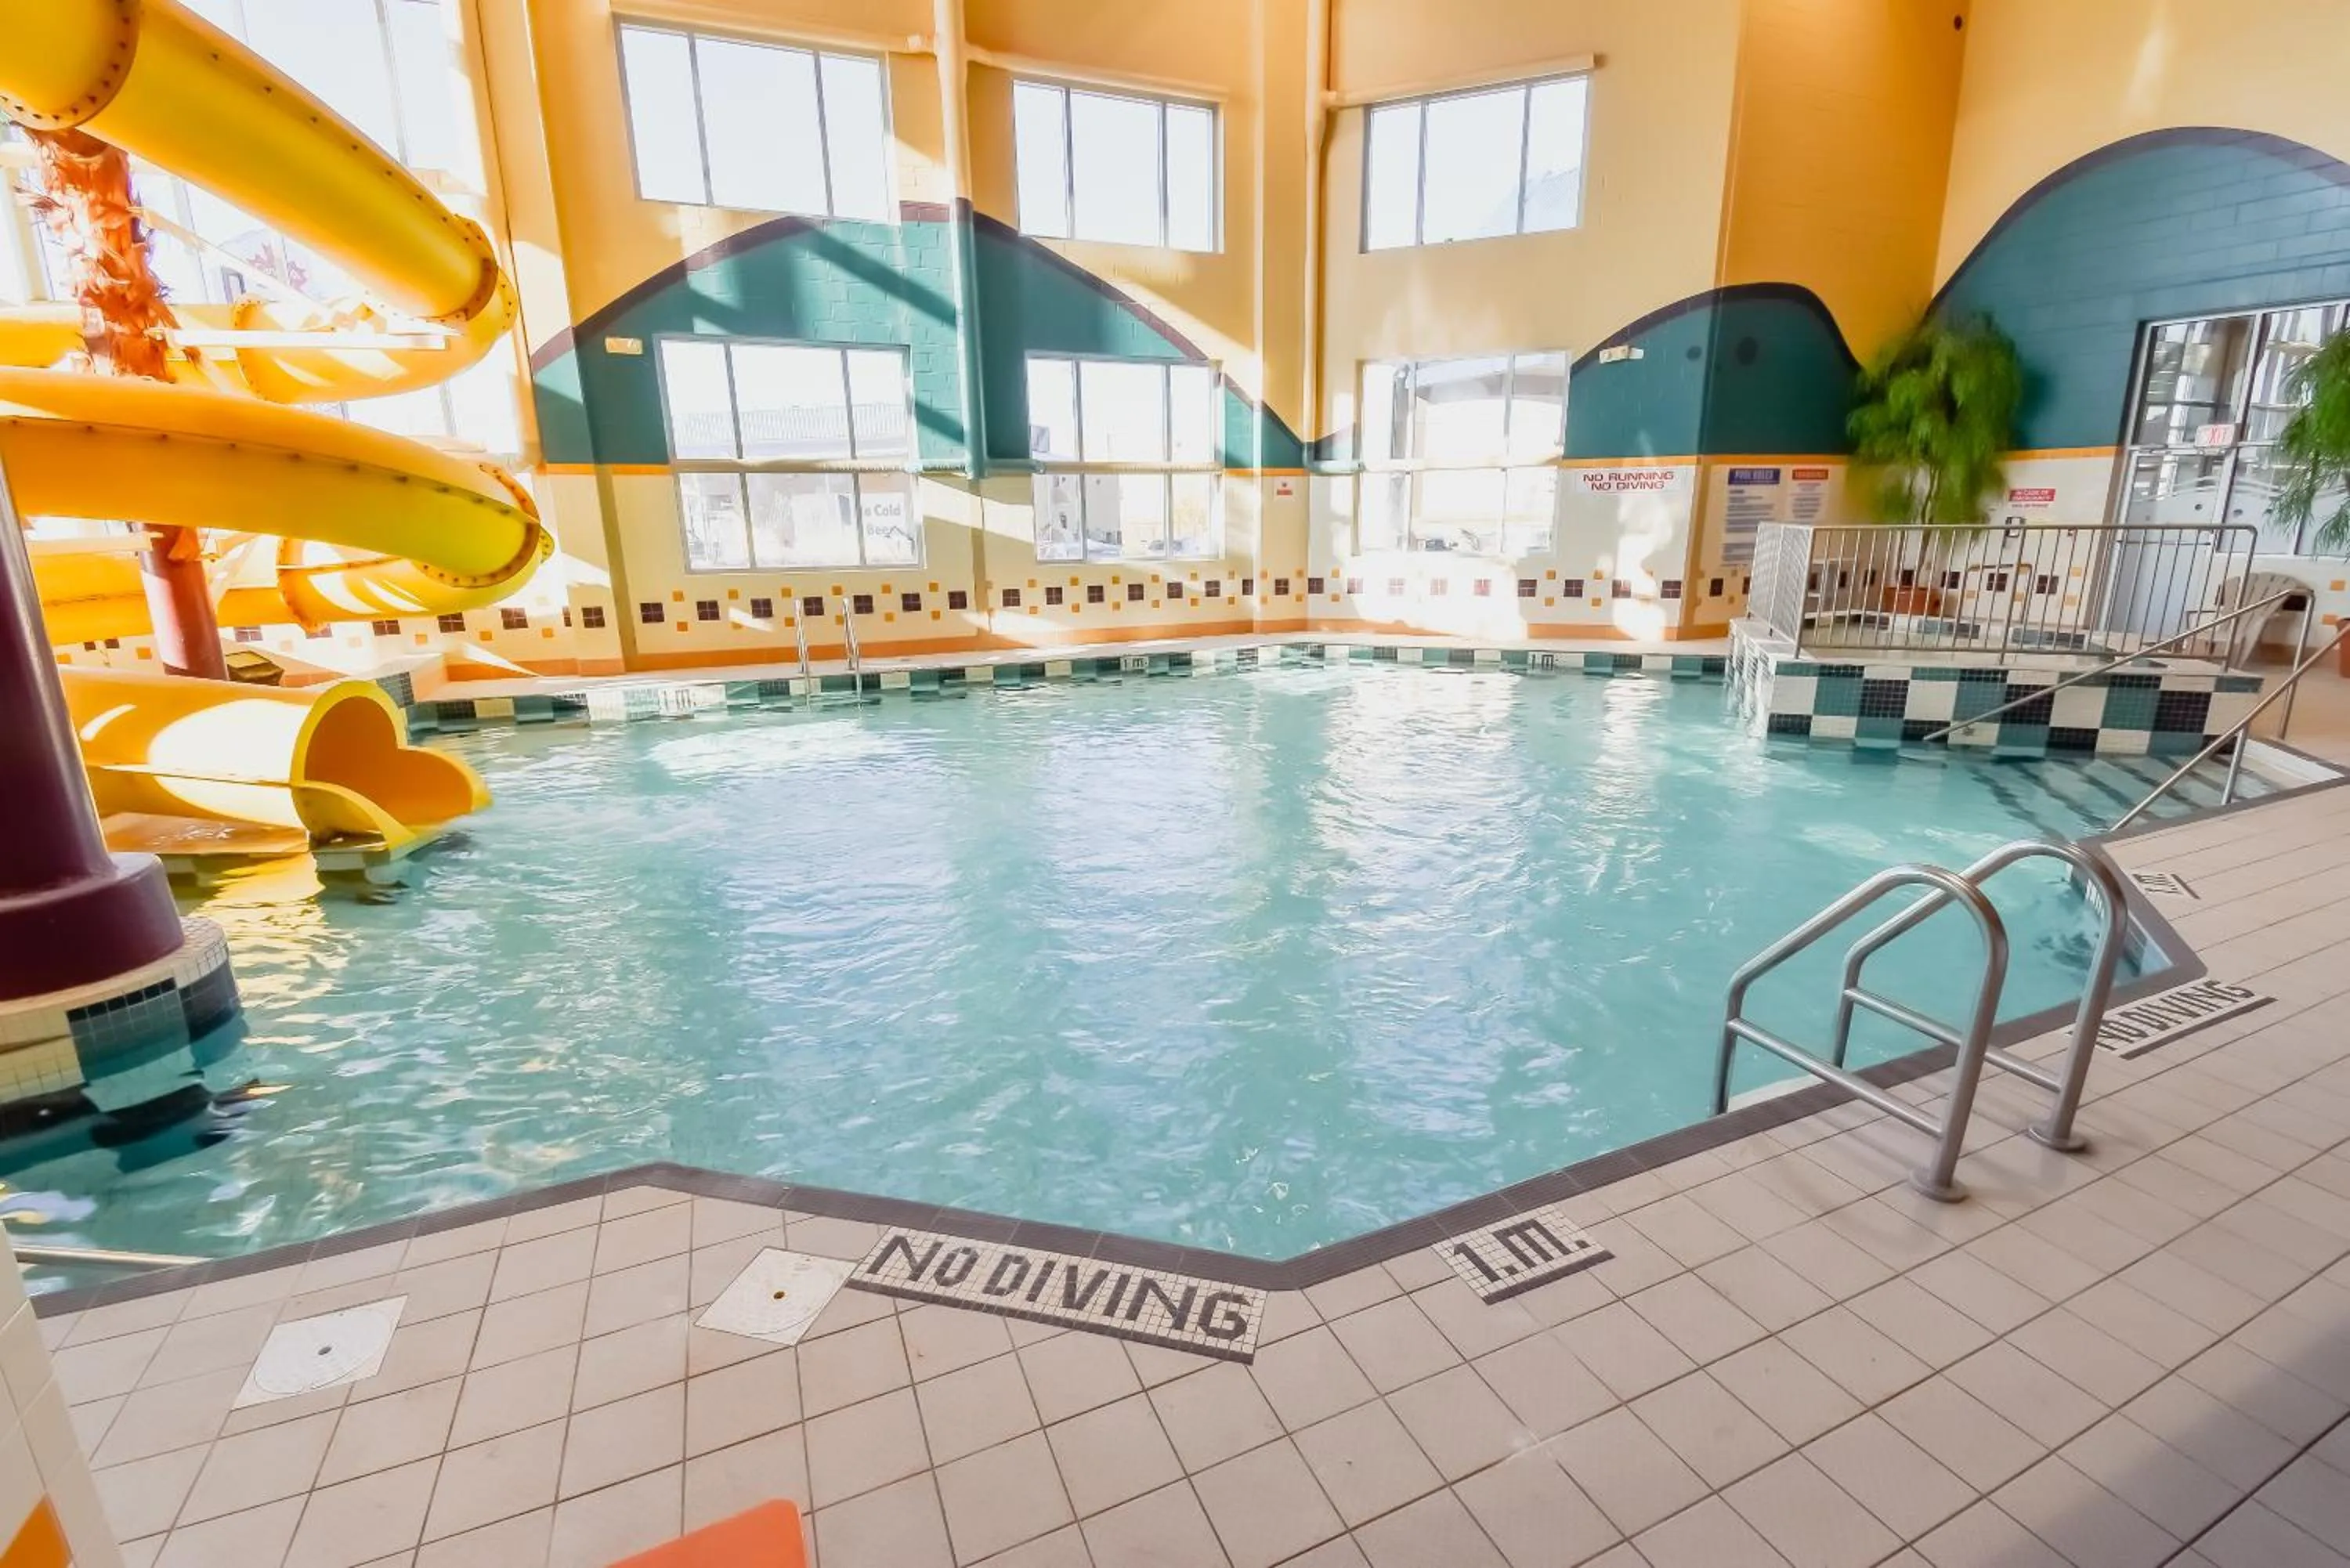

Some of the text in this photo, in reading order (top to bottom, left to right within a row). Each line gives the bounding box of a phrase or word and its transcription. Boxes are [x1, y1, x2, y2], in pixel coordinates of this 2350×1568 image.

[1583, 471, 1675, 482] NO RUNNING
[1591, 481, 1665, 491] NO DIVING
[2118, 980, 2256, 1031] DIVING
[867, 1235, 1251, 1342] NO DIVING
